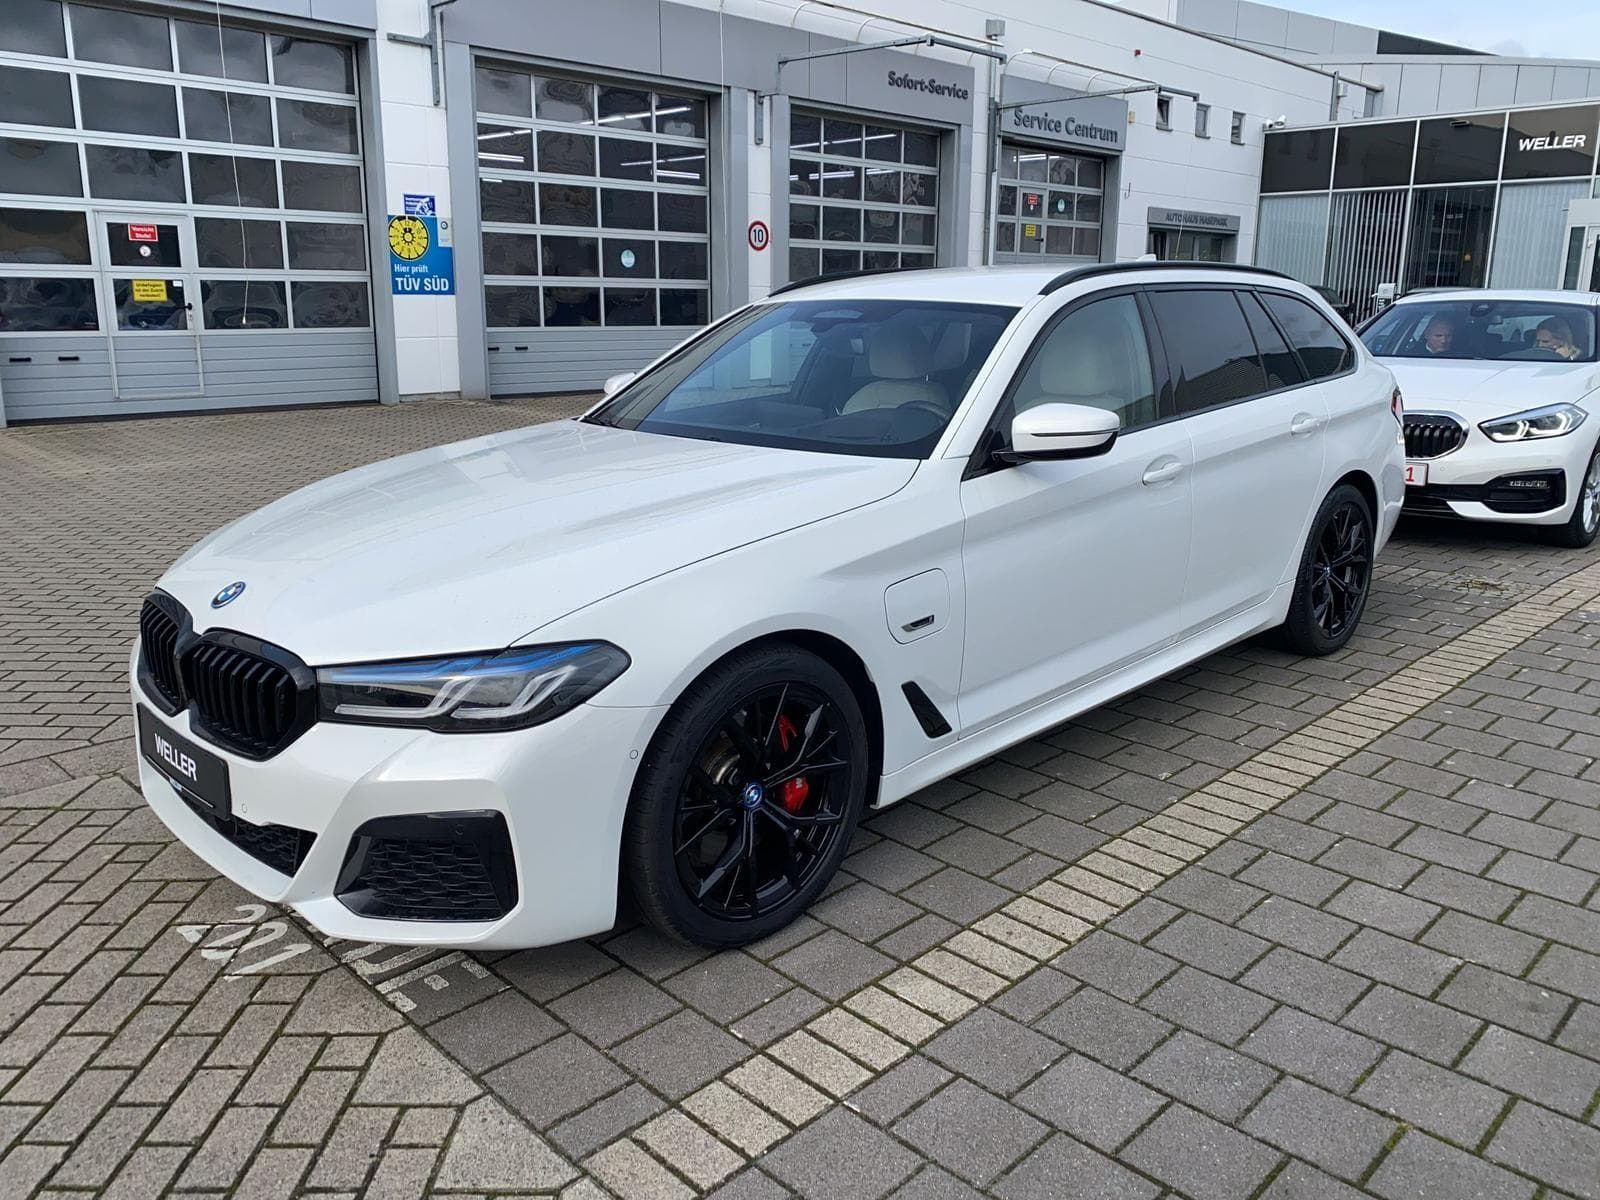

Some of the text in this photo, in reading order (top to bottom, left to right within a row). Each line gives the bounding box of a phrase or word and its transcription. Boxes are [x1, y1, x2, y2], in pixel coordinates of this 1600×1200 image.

[887, 70, 969, 100] Sofort-Service
[1013, 107, 1118, 143] Service Centrum
[1519, 135, 1586, 151] WELLER
[753, 229, 764, 243] 10
[394, 263, 428, 274] Hier prüft
[395, 274, 449, 292] TÜV SÜD
[154, 732, 197, 781] WELLER
